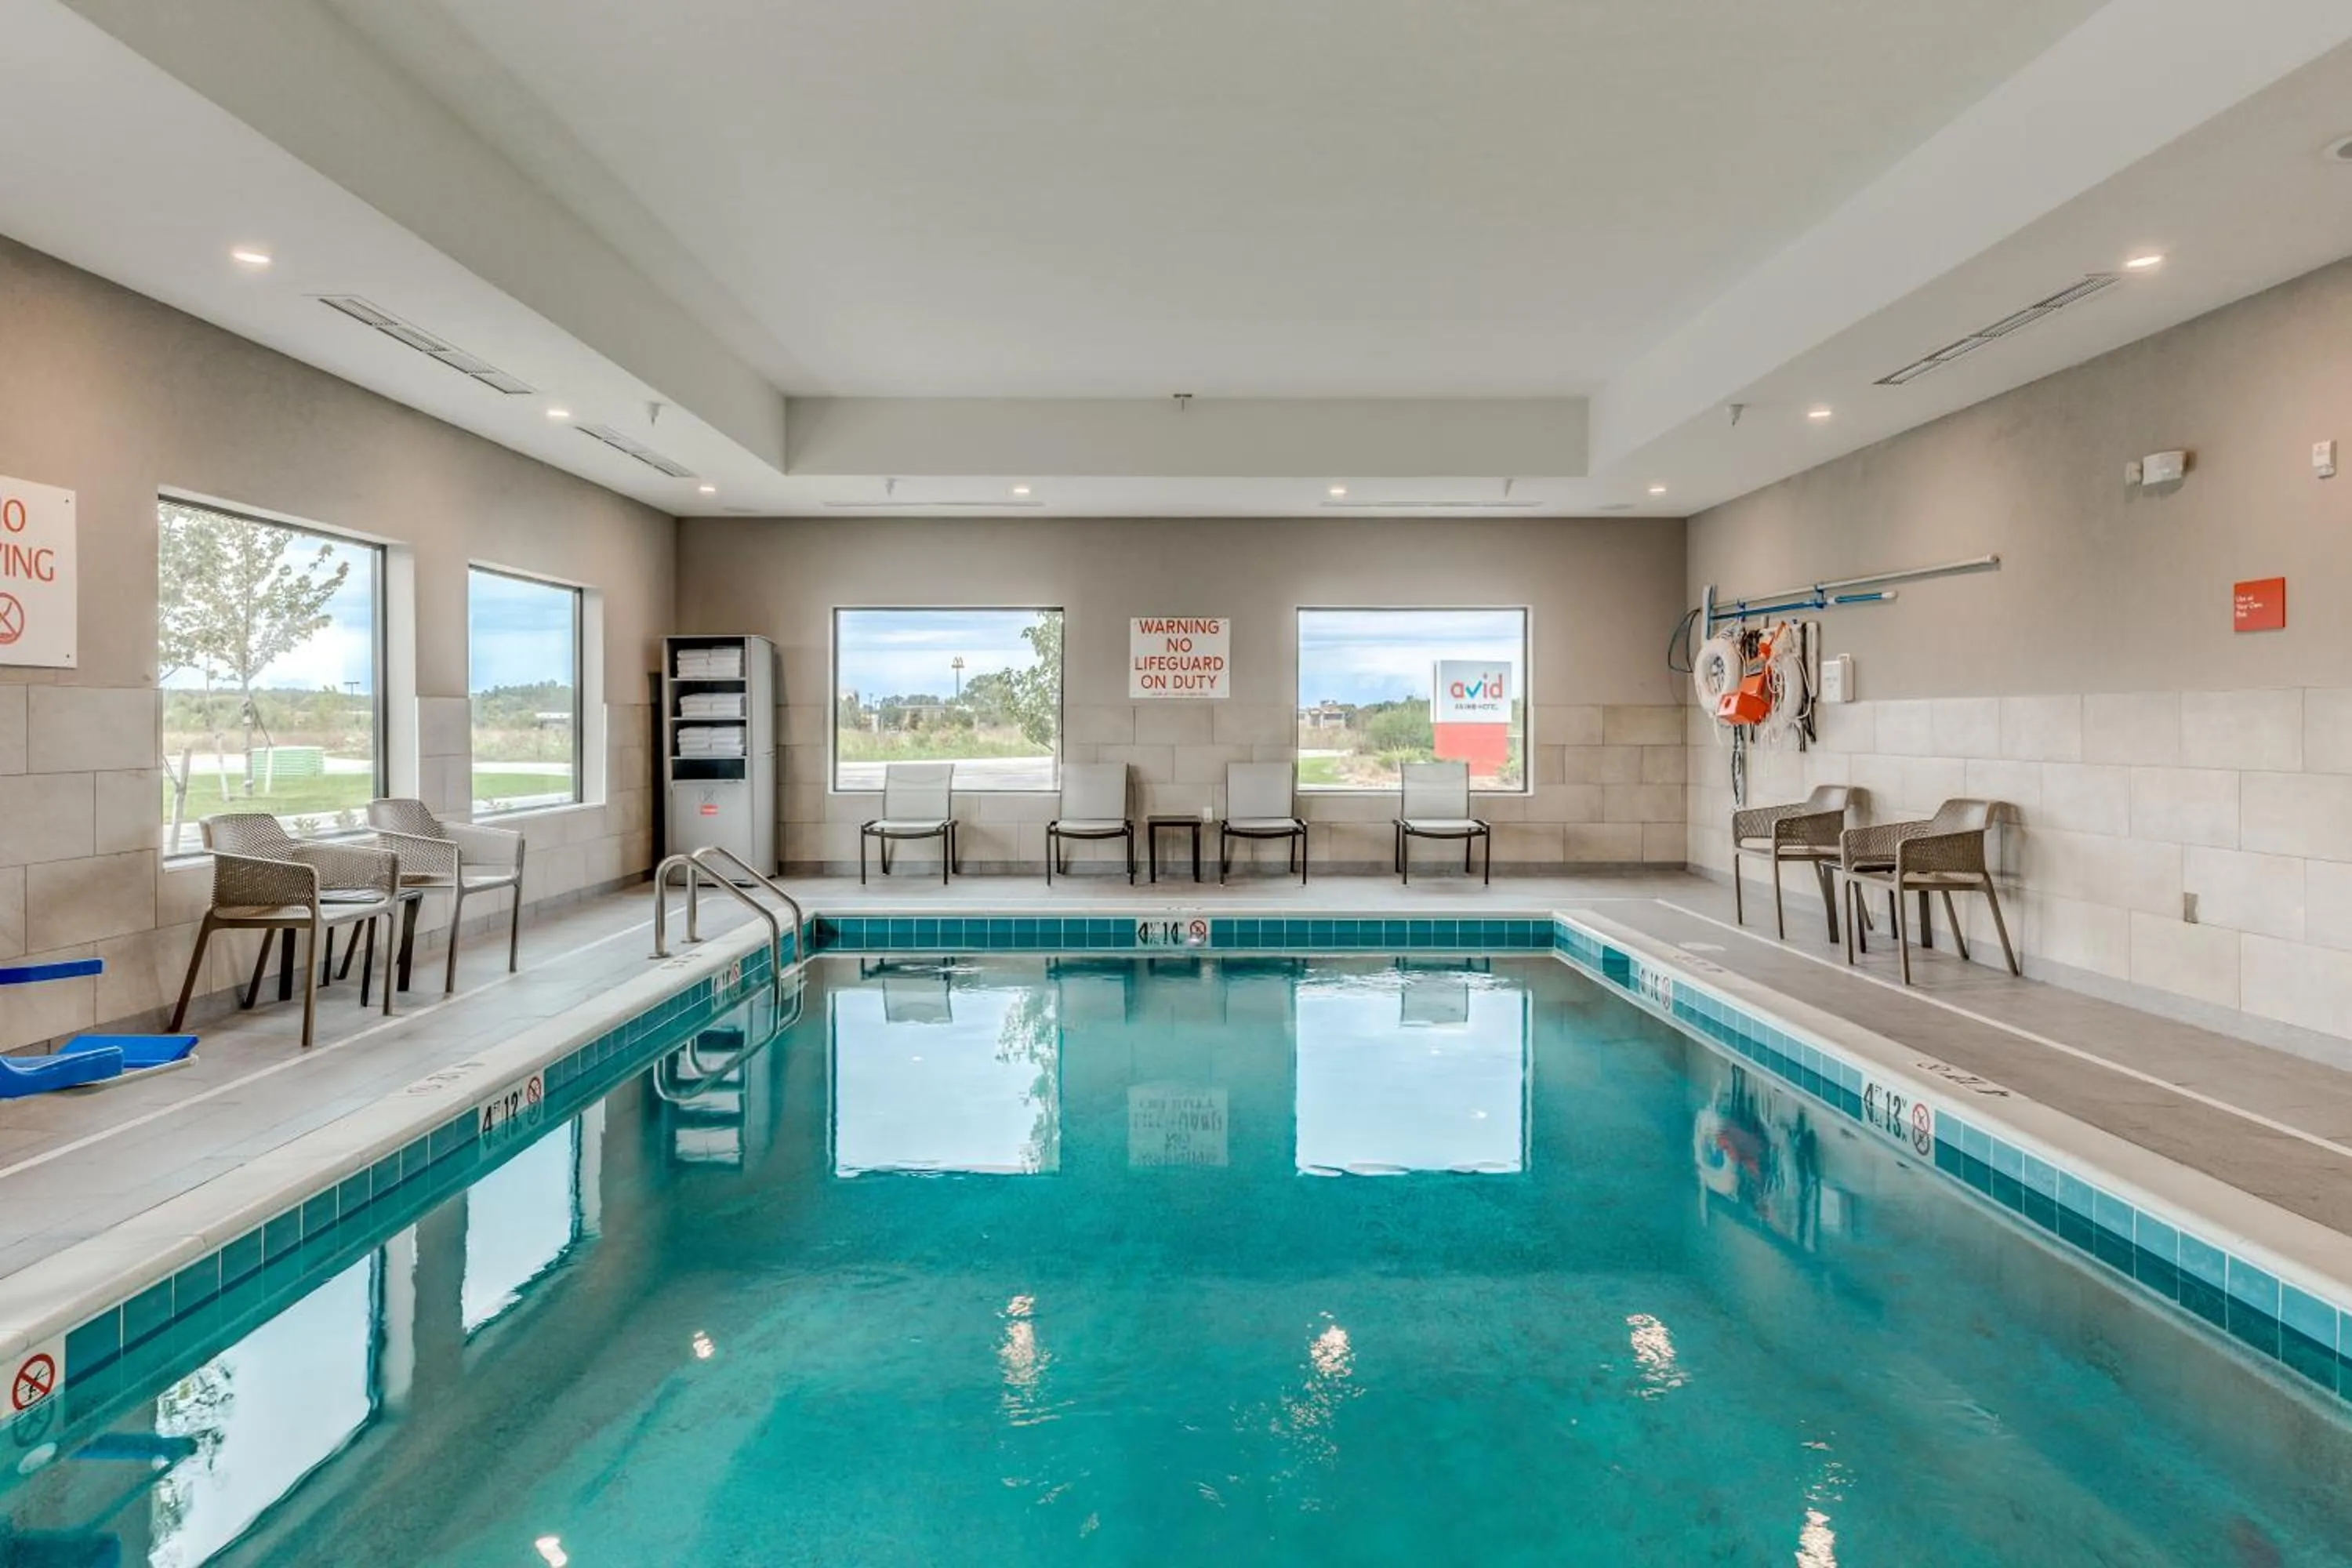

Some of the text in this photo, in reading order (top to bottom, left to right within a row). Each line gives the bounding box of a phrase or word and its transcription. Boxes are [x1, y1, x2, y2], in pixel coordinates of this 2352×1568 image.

[0, 499, 26, 532] O
[0, 543, 55, 583] ING
[1139, 619, 1220, 634] WARNING
[1167, 637, 1192, 652] NO
[1134, 656, 1224, 670] LIFEGUARD
[1141, 674, 1218, 689] ON DUTY
[1450, 673, 1503, 699] avid
